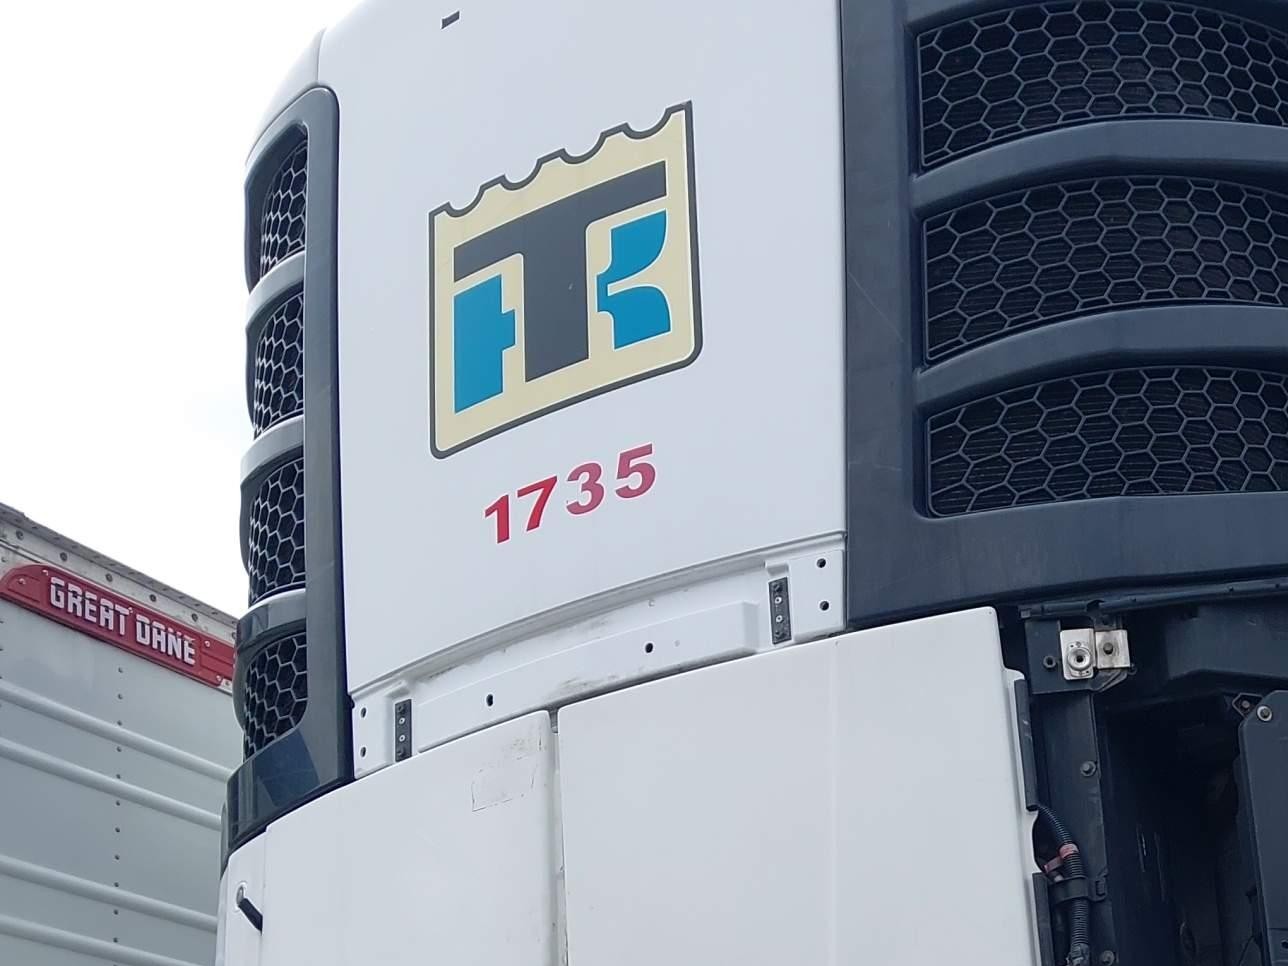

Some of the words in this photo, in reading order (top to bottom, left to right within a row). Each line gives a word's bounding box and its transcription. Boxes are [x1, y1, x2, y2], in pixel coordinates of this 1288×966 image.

[483, 443, 657, 544] 1735
[51, 576, 129, 636] GREAT
[136, 614, 196, 665] DANE
